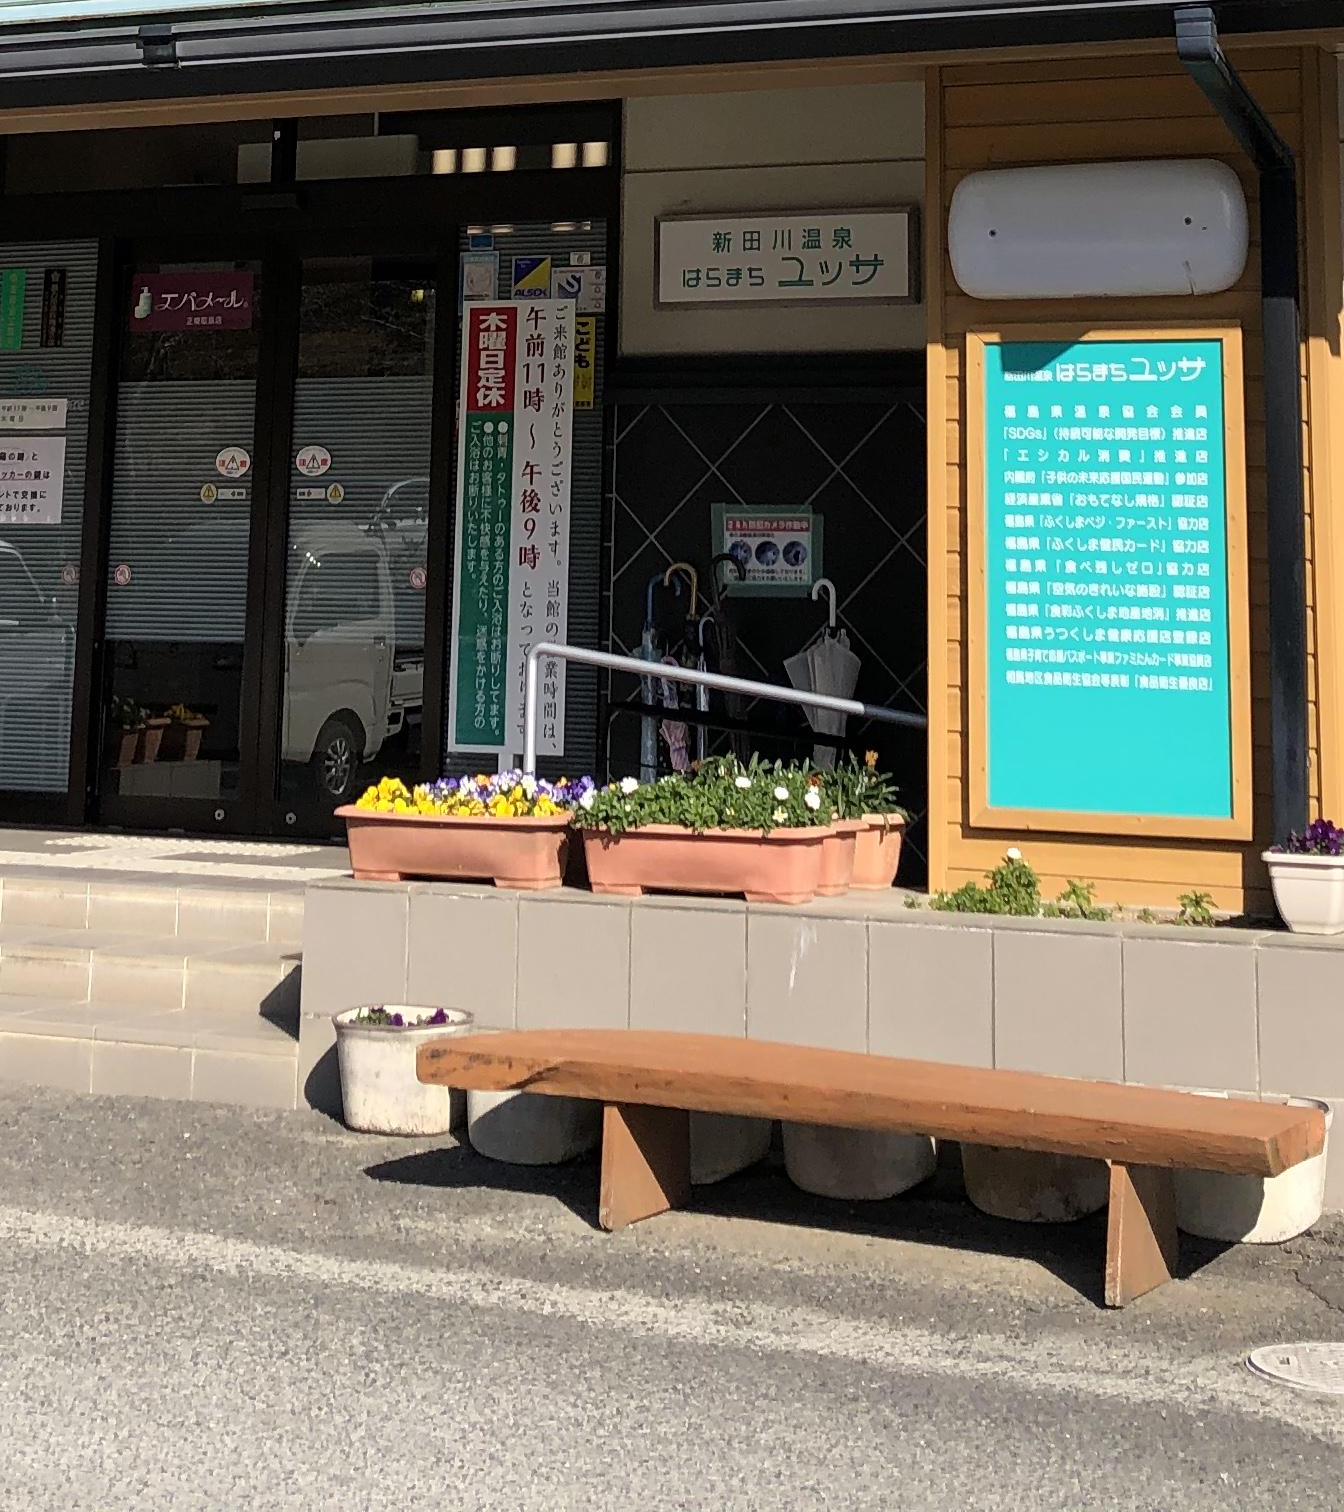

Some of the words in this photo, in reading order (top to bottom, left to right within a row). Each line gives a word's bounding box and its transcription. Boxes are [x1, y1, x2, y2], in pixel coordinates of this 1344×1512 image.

[712, 227, 852, 253] 新田川温泉
[682, 266, 765, 288] はらまち
[778, 253, 885, 287] ユッサ
[477, 312, 508, 407] 木曜日定休
